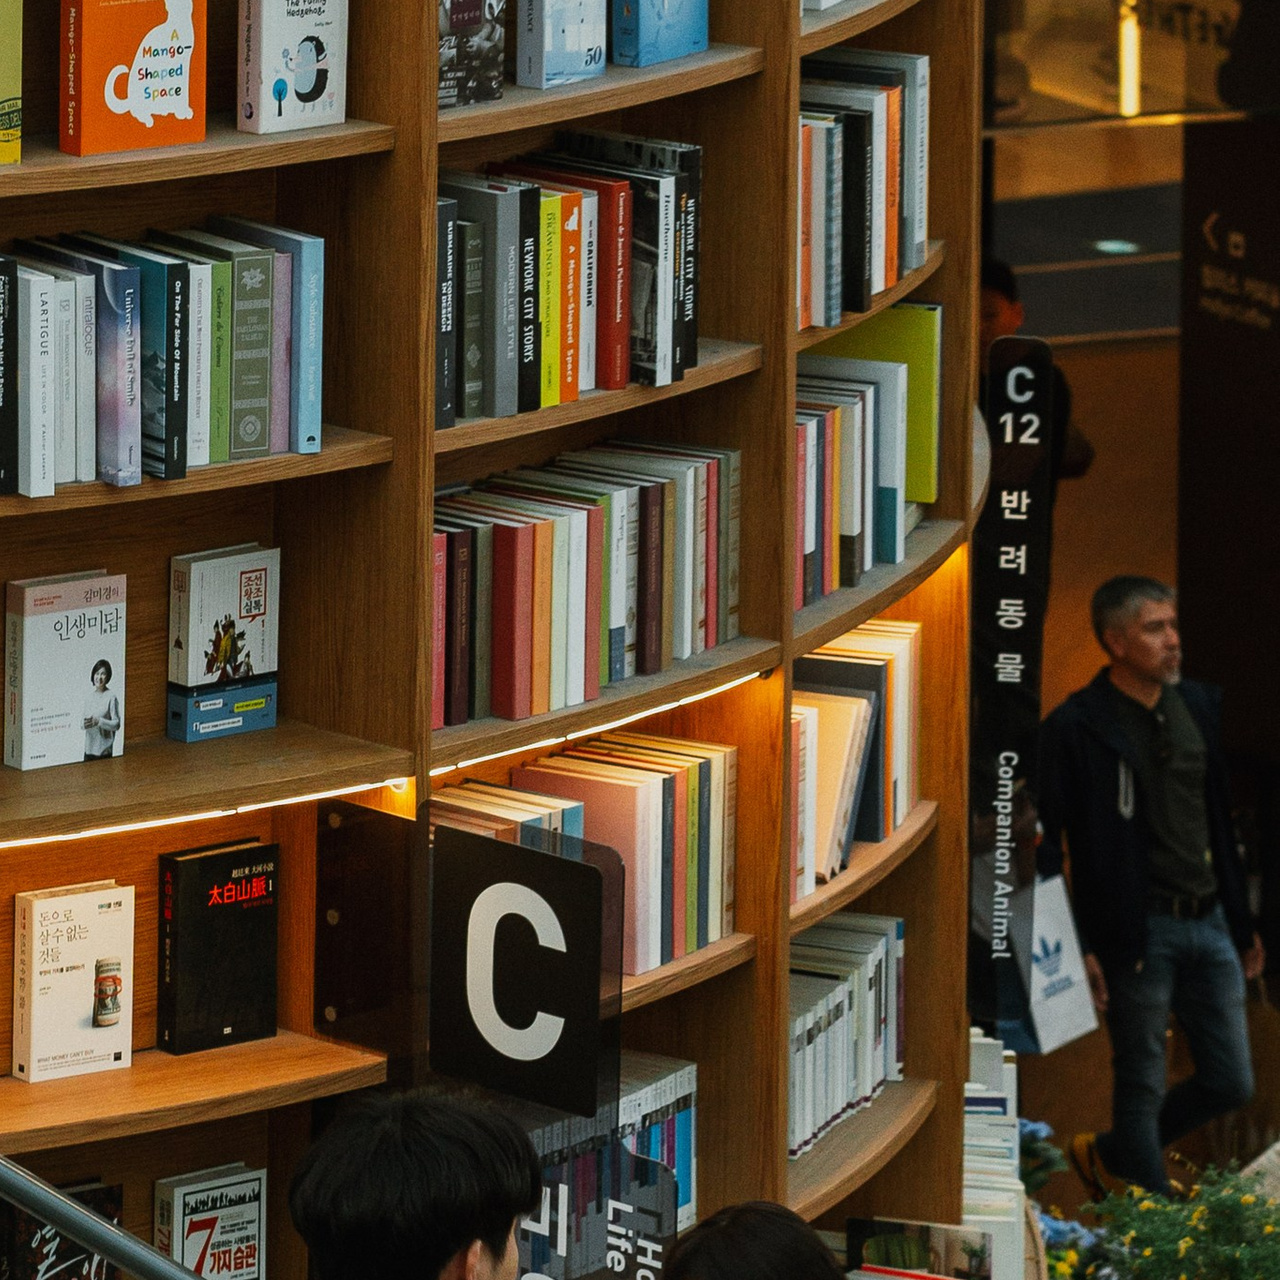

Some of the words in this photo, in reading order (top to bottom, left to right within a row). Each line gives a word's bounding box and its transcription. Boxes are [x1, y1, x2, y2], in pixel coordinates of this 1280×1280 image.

[171, 29, 179, 41] A
[68, 8, 76, 95] Mango-Shaped
[142, 45, 193, 59] Mango-
[584, 45, 602, 67] 50
[137, 63, 183, 82] Shaped
[144, 85, 182, 100] Space
[68, 100, 76, 136] Space
[524, 237, 534, 292] NEWYORK
[569, 245, 576, 254] A
[175, 281, 182, 292] On
[586, 240, 594, 307] CALIFORNIA
[174, 295, 182, 309] The
[523, 297, 533, 320] CITY
[567, 259, 576, 343] Mango-Shaped
[39, 291, 49, 356] LARTIGUE
[174, 350, 181, 360] Of
[523, 326, 534, 363] STORYS
[173, 362, 181, 402] Mountain
[566, 349, 574, 383] Space
[1006, 367, 1035, 403] C
[998, 412, 1040, 444] 12
[83, 587, 120, 604] 김미경의
[53, 609, 122, 641] 인생미답
[995, 751, 1019, 873] Companion
[207, 878, 267, 907] 太白山脈
[38, 910, 74, 926] 돈으로
[991, 879, 1012, 960] Animal
[38, 948, 62, 965] 것들
[466, 881, 567, 1061] C
[184, 1215, 219, 1278] 7
[210, 1239, 232, 1251] 성공하는
[233, 1233, 257, 1248] 사람들의
[606, 1199, 634, 1272] Life
[210, 1249, 232, 1275] 가지
[233, 1243, 257, 1272] 습관
